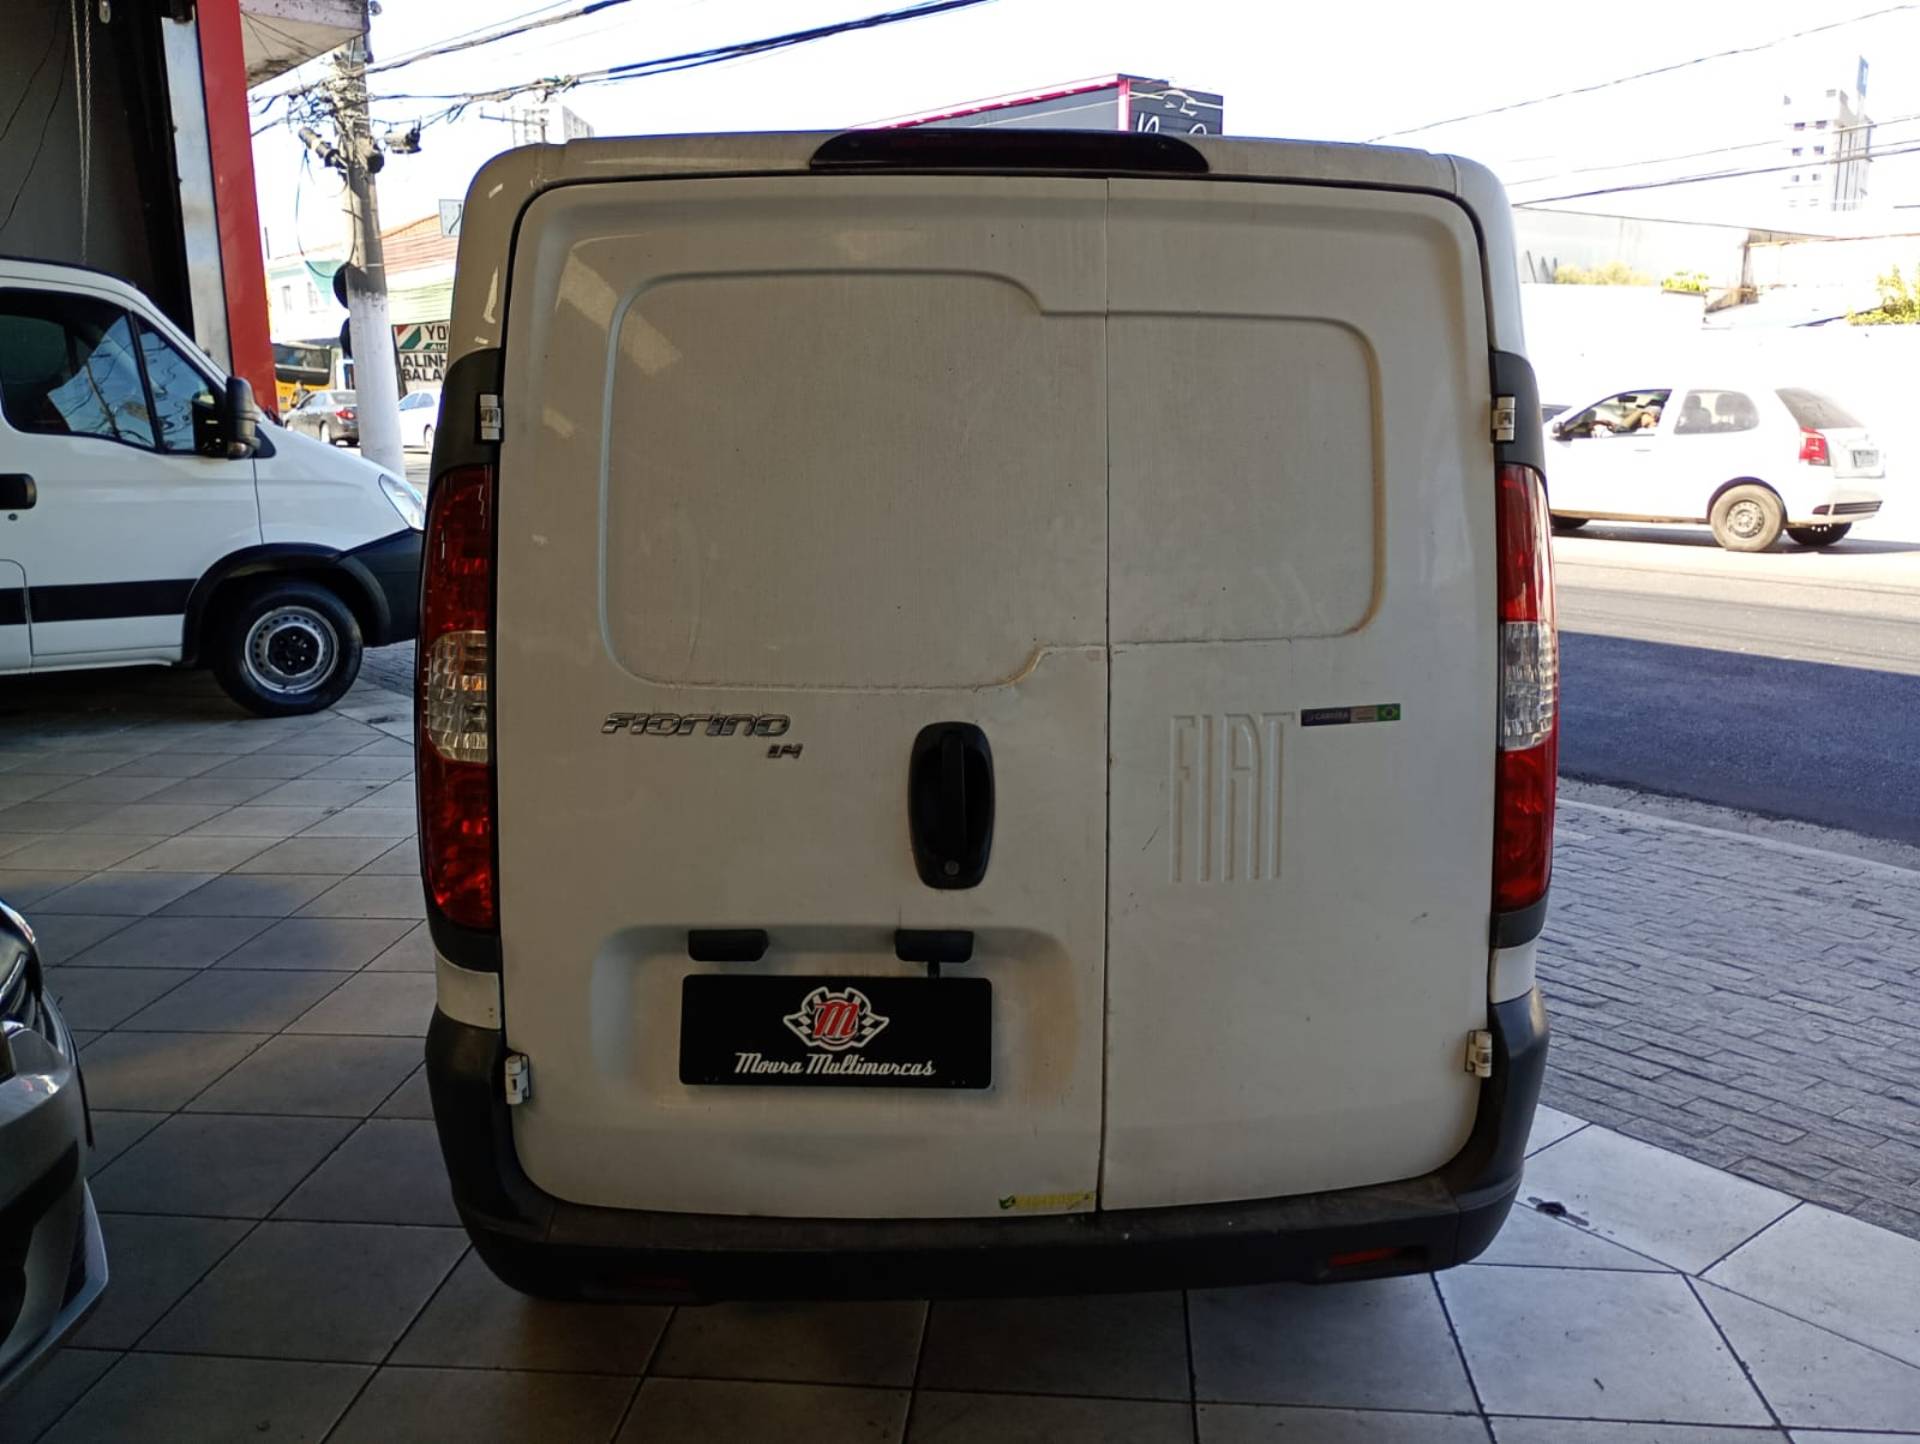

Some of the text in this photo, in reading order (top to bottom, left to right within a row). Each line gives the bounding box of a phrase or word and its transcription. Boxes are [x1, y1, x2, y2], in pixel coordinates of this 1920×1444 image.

[425, 325, 449, 341] YO
[402, 368, 446, 382] BALA
[1169, 711, 1296, 883] FIAT
[734, 1052, 936, 1076] Moura Multimarcas
